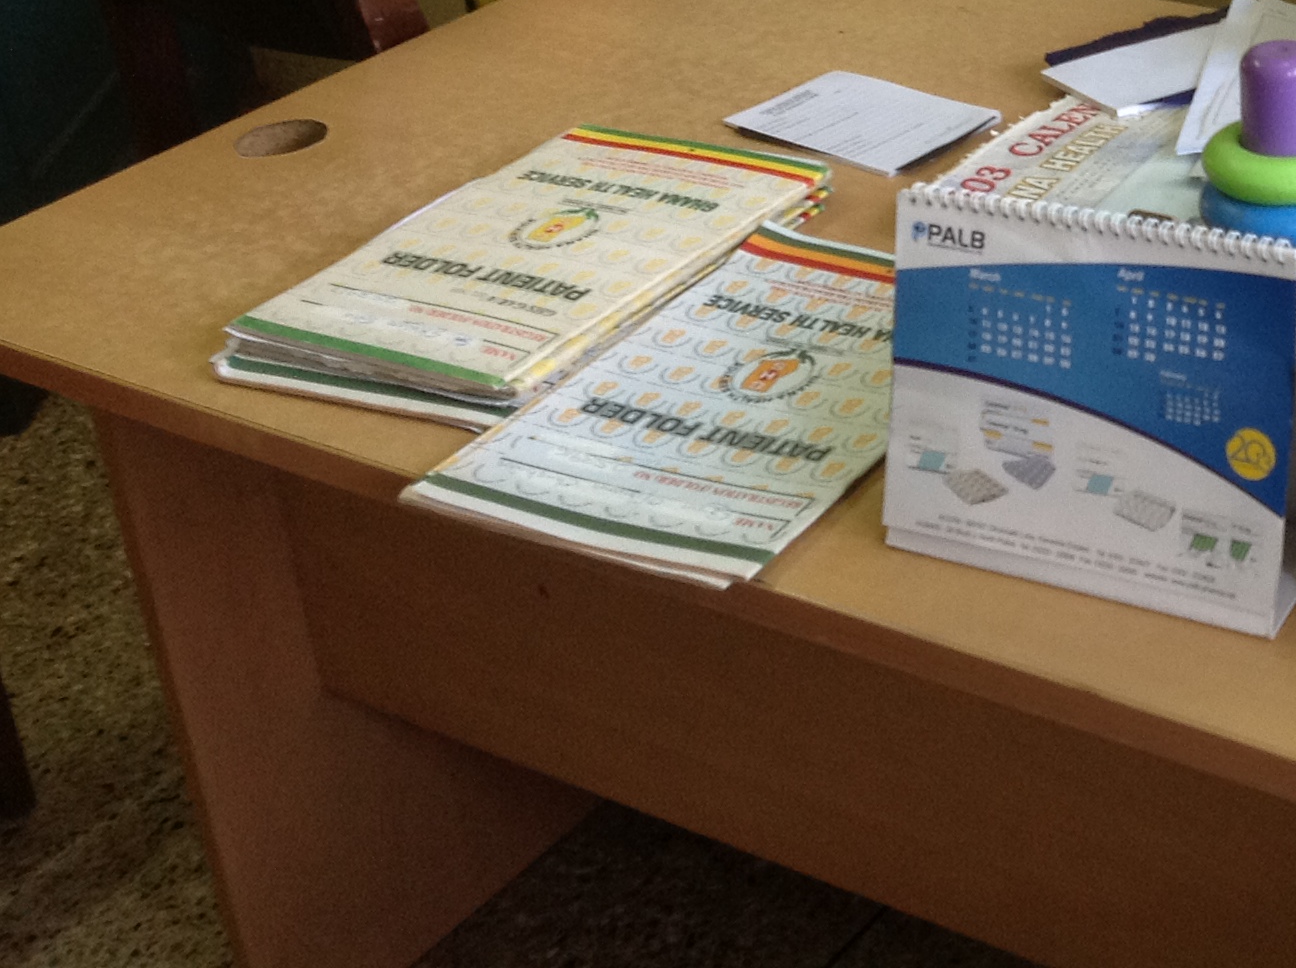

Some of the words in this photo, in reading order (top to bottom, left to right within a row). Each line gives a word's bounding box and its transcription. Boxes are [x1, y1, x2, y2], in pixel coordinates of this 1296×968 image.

[960, 166, 1012, 193] 03
[1009, 101, 1101, 157] CALEN
[1041, 122, 1129, 172] HEALTH
[517, 170, 592, 189] SERVICE
[587, 180, 659, 204] HEALTH
[926, 224, 986, 250] PALB
[381, 250, 480, 278] FOLDER
[477, 268, 592, 301] PATIENT
[702, 294, 791, 323] SERVICE
[789, 315, 872, 338] HEALTH
[579, 398, 704, 435] FOLDER
[699, 426, 836, 463] PATIENT
